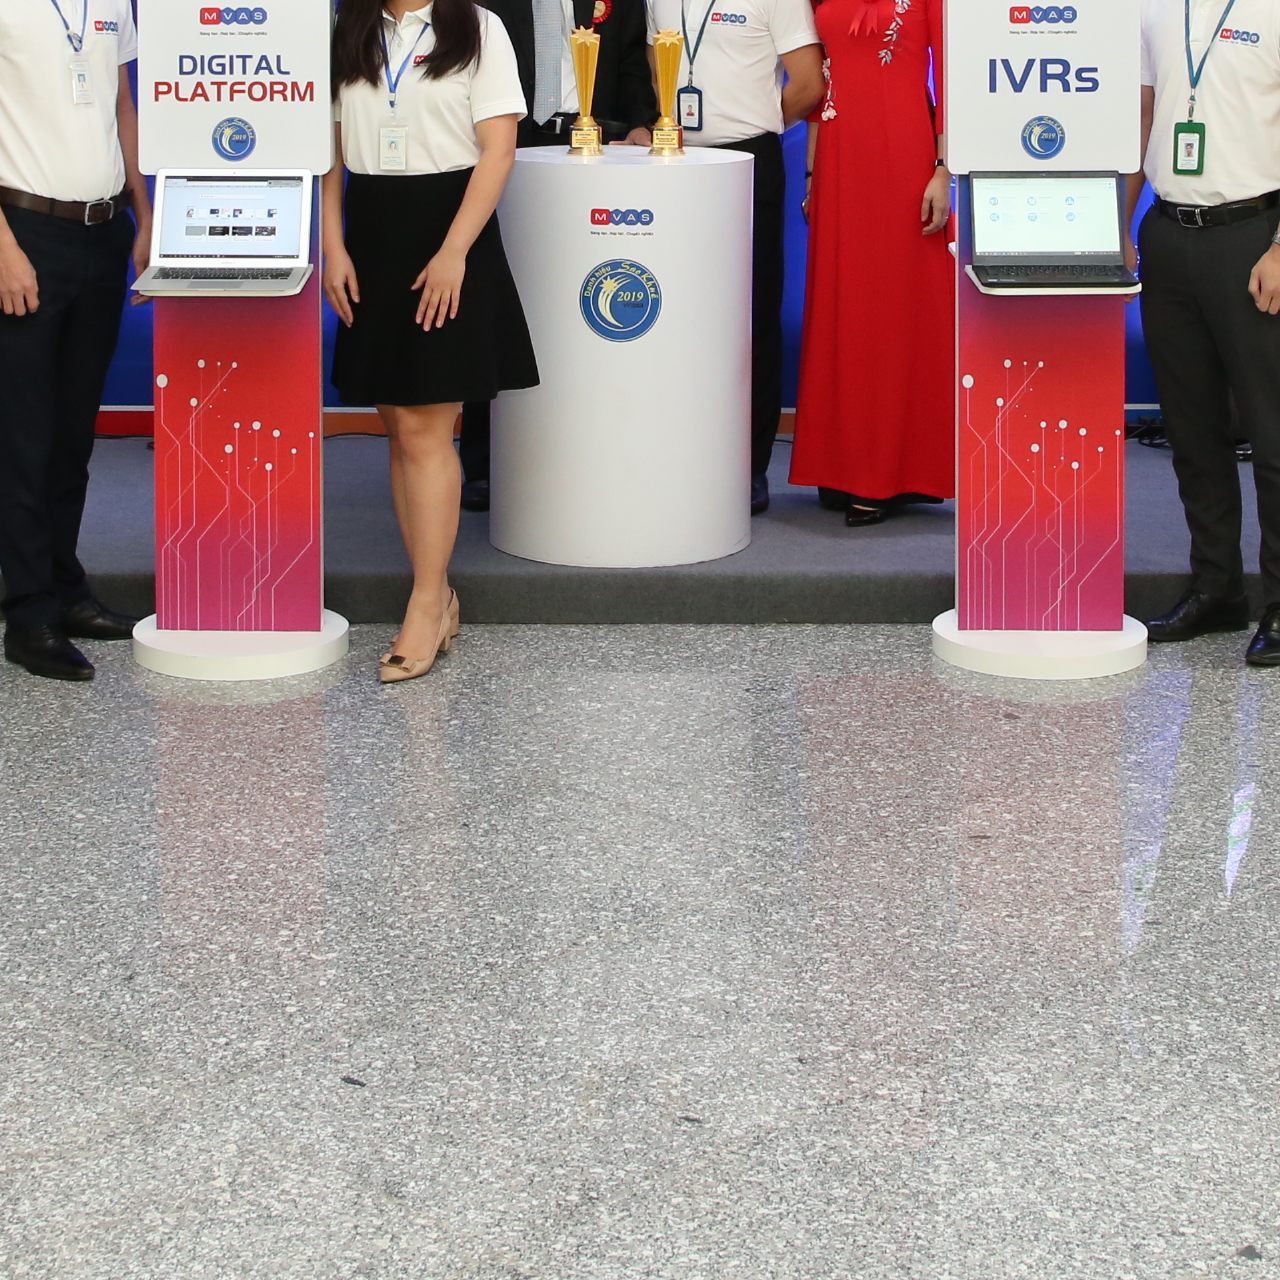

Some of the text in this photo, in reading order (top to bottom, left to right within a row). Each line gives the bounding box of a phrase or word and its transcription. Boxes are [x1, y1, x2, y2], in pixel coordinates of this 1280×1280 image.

[202, 10, 265, 22] MVAS
[1012, 9, 1075, 21] MVAS
[179, 55, 290, 75] DIGITAL
[989, 59, 1100, 93] IVRs
[154, 81, 315, 102] PLATFORM
[592, 211, 652, 224] MVAS
[584, 277, 597, 297] Danh
[617, 291, 644, 301] 2019
